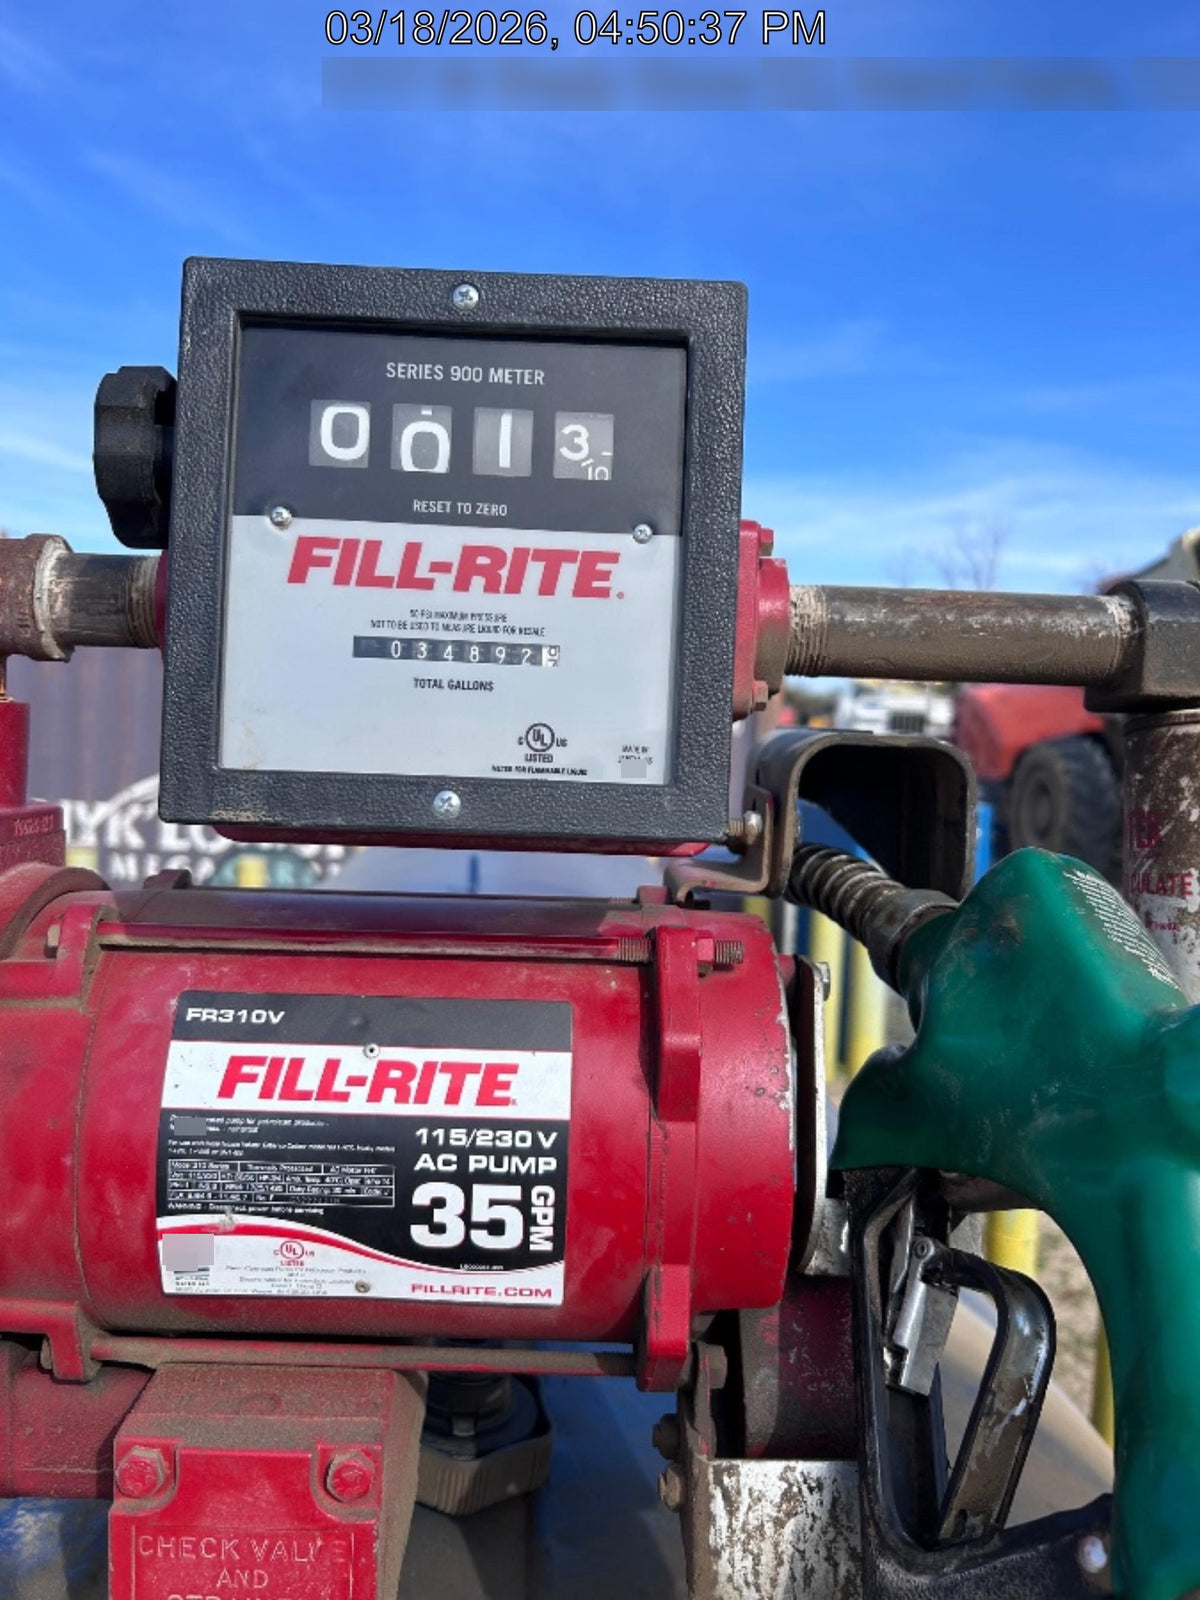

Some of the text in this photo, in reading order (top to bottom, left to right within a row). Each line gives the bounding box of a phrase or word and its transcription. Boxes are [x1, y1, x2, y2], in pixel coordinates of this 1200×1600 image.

[386, 362, 545, 385] SERIES 900 METER
[413, 499, 507, 516] RESET TO ZERO
[287, 535, 621, 598] FILL-RITE
[414, 677, 494, 692] TOTAL GALLONS
[525, 753, 554, 763] LISTED
[186, 1008, 286, 1025] FR310V
[217, 1055, 519, 1106] FILL-RITE
[415, 1127, 533, 1148] 115/230
[537, 1132, 558, 1149] V
[413, 1153, 558, 1175] AC PUMP
[410, 1181, 524, 1249] 35
[529, 1185, 555, 1251] GPM
[412, 1283, 552, 1297] FILLRITE.COM
[139, 1535, 240, 1561] CHECK
[216, 1568, 269, 1589] AND
